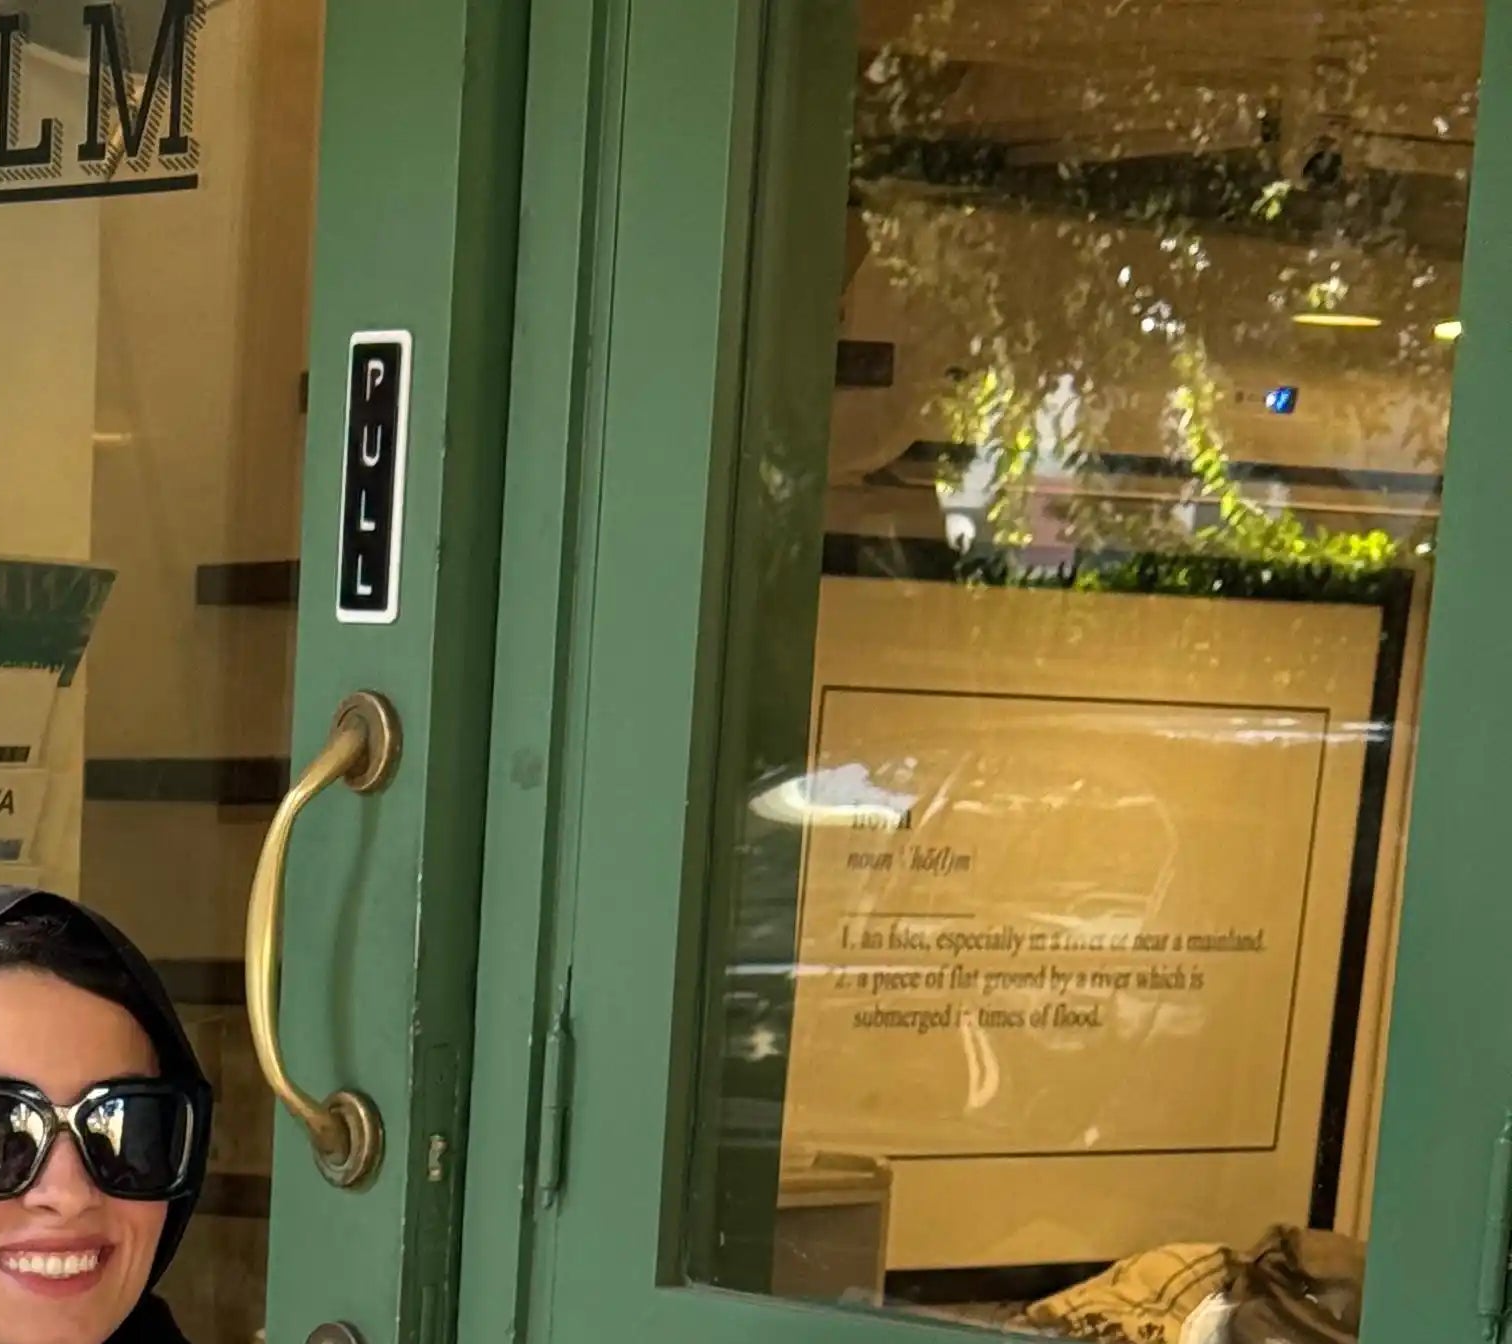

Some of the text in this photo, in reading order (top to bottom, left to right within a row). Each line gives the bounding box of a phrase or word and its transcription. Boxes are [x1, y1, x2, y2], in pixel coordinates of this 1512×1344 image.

[356, 358, 385, 596] PULL
[936, 925, 1024, 957] especially
[872, 967, 920, 995] piece
[925, 964, 948, 990] of
[949, 963, 978, 990] flat
[982, 964, 1046, 996] ground
[1050, 964, 1073, 996] by
[1137, 964, 1186, 990] which
[1189, 963, 1205, 990] is
[853, 1003, 952, 1034] submerged
[978, 1003, 1025, 1028] times
[1029, 1002, 1050, 1028] of
[1052, 1002, 1103, 1028] flood.
